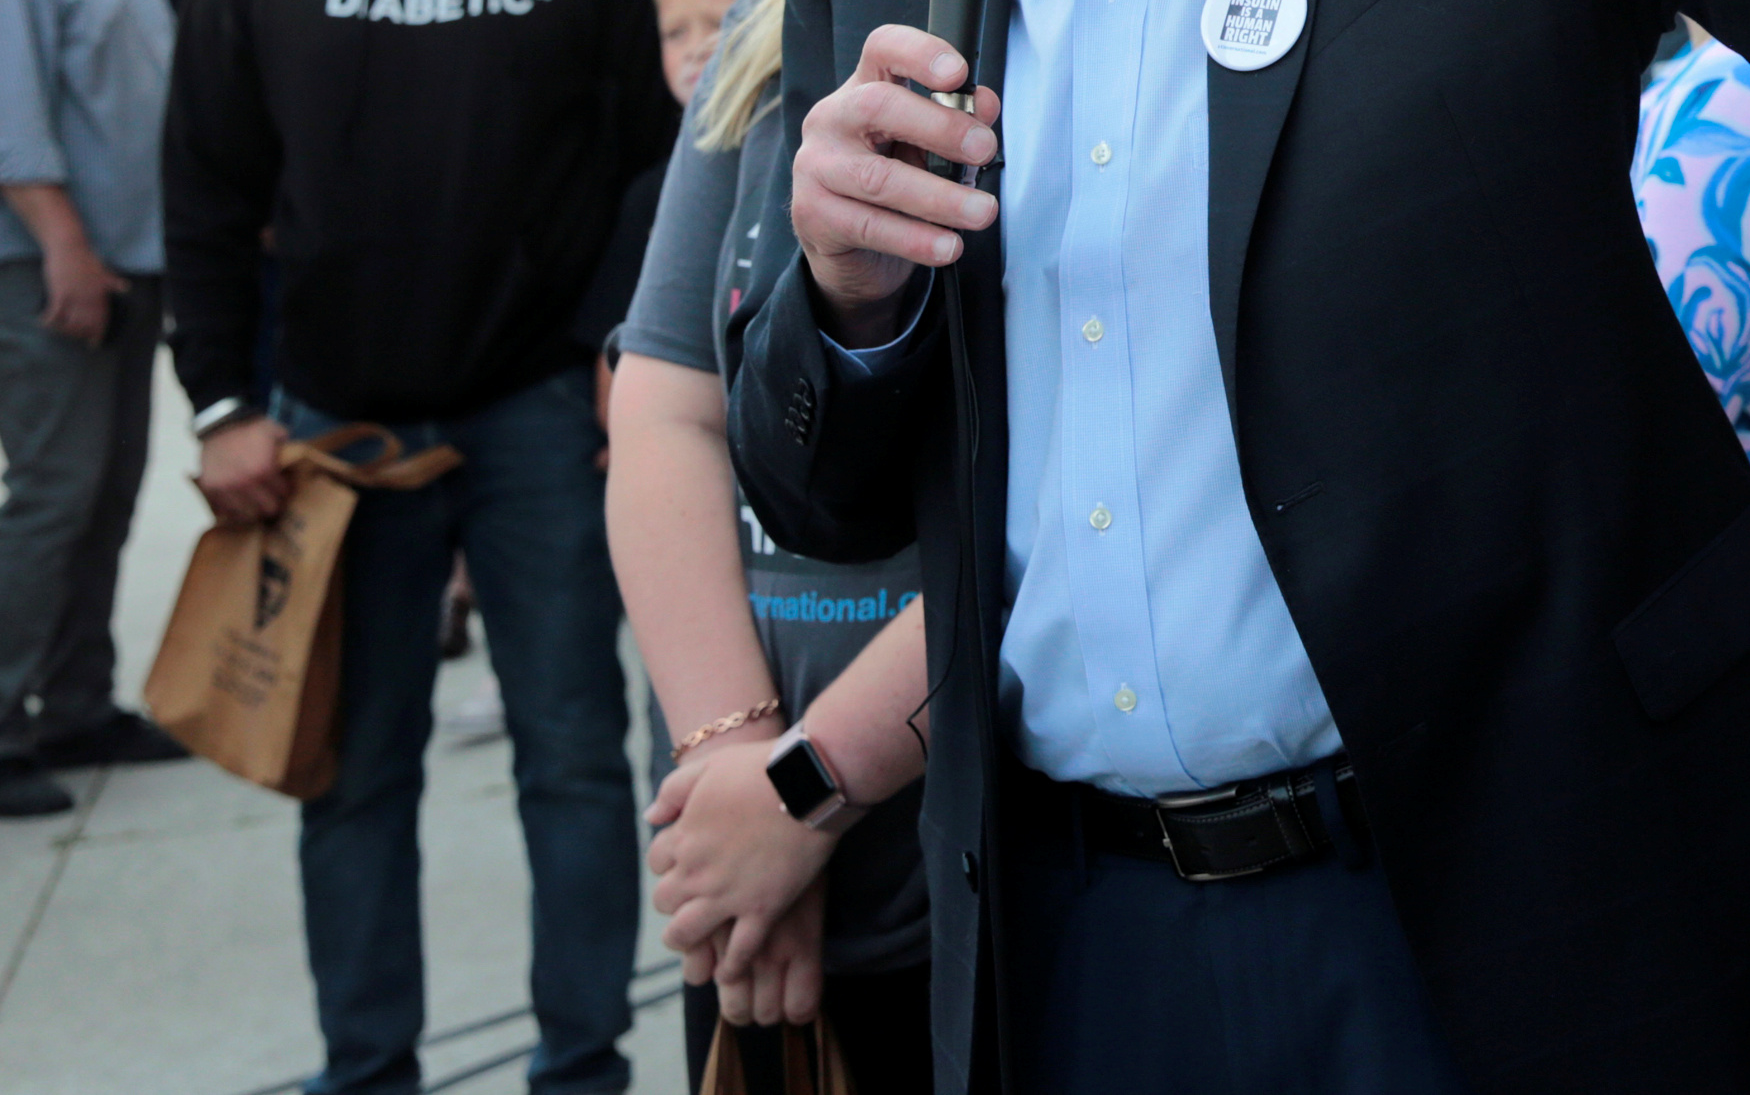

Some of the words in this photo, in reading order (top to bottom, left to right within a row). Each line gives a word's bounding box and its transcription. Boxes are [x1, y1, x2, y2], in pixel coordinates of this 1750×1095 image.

[1241, 6, 1253, 17] IS
[1255, 9, 1264, 19] A
[1225, 15, 1273, 32] HUMAN
[1223, 27, 1269, 45] RIGHT
